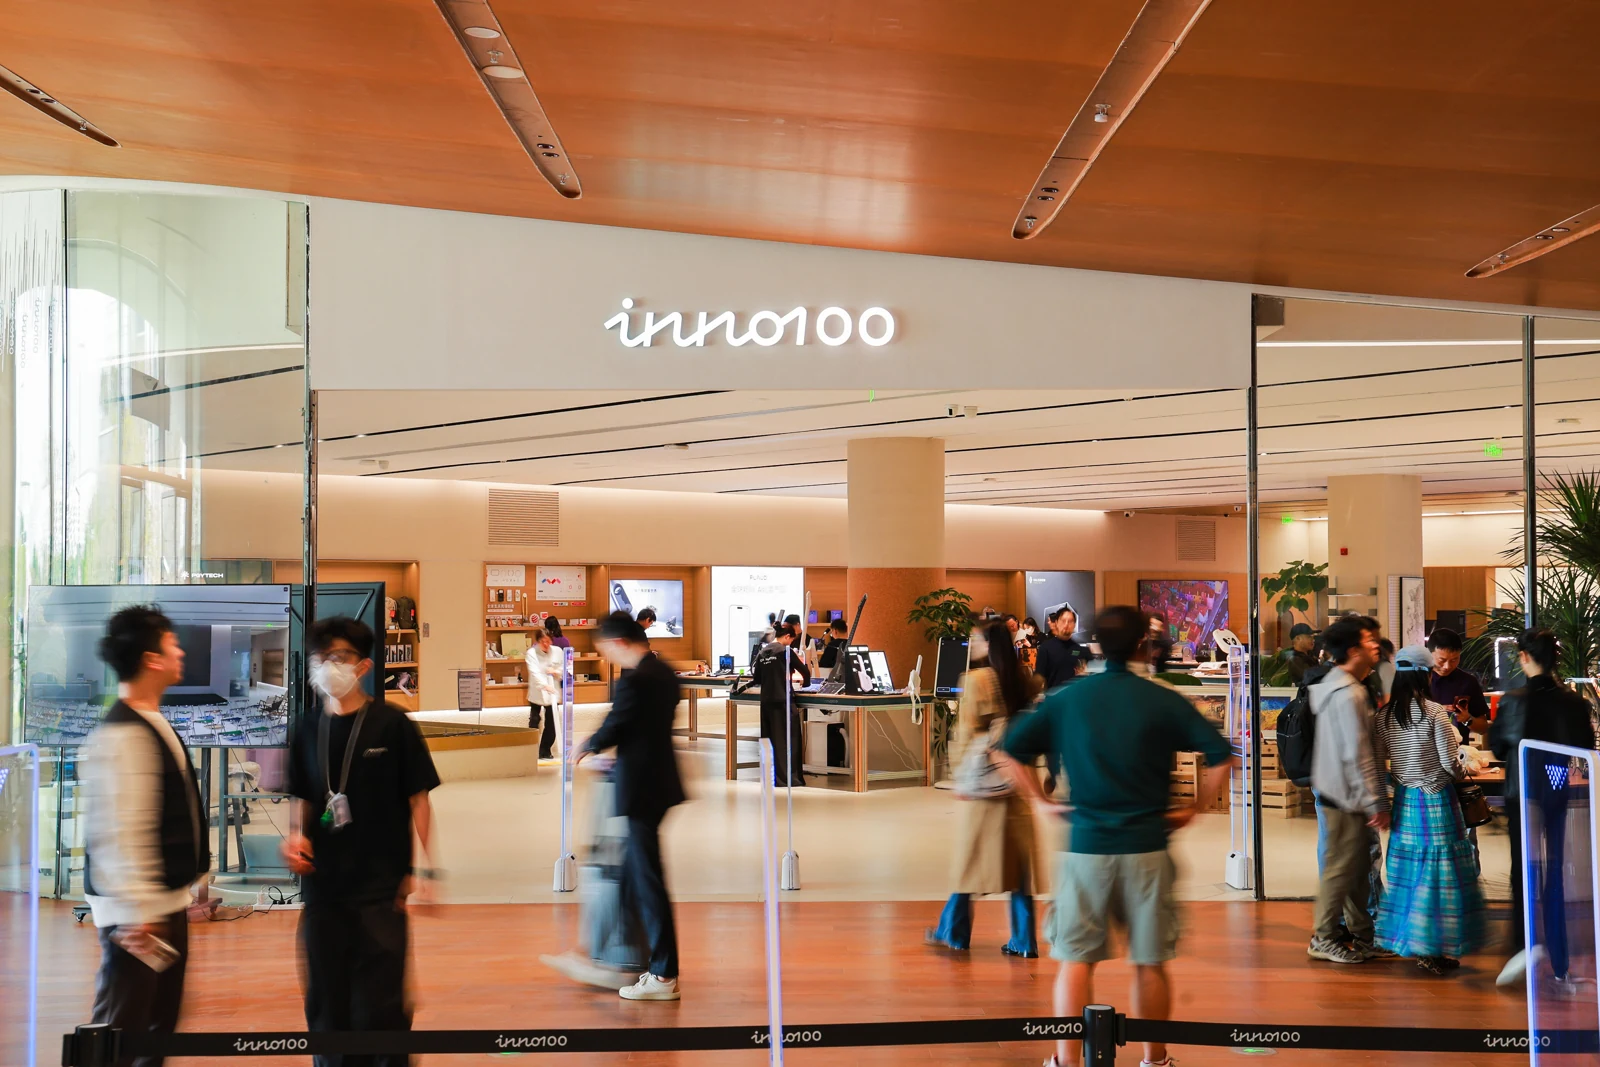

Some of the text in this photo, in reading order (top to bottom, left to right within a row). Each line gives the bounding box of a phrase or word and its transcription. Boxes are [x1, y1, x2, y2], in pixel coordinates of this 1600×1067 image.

[604, 297, 895, 348] inno100
[1022, 1022, 1083, 1035] inno10
[1230, 1028, 1301, 1042] inno100
[495, 1034, 568, 1048] inno100
[751, 1030, 822, 1044] ino100
[1483, 1033, 1551, 1047] inno00
[233, 1037, 308, 1052] inno100
